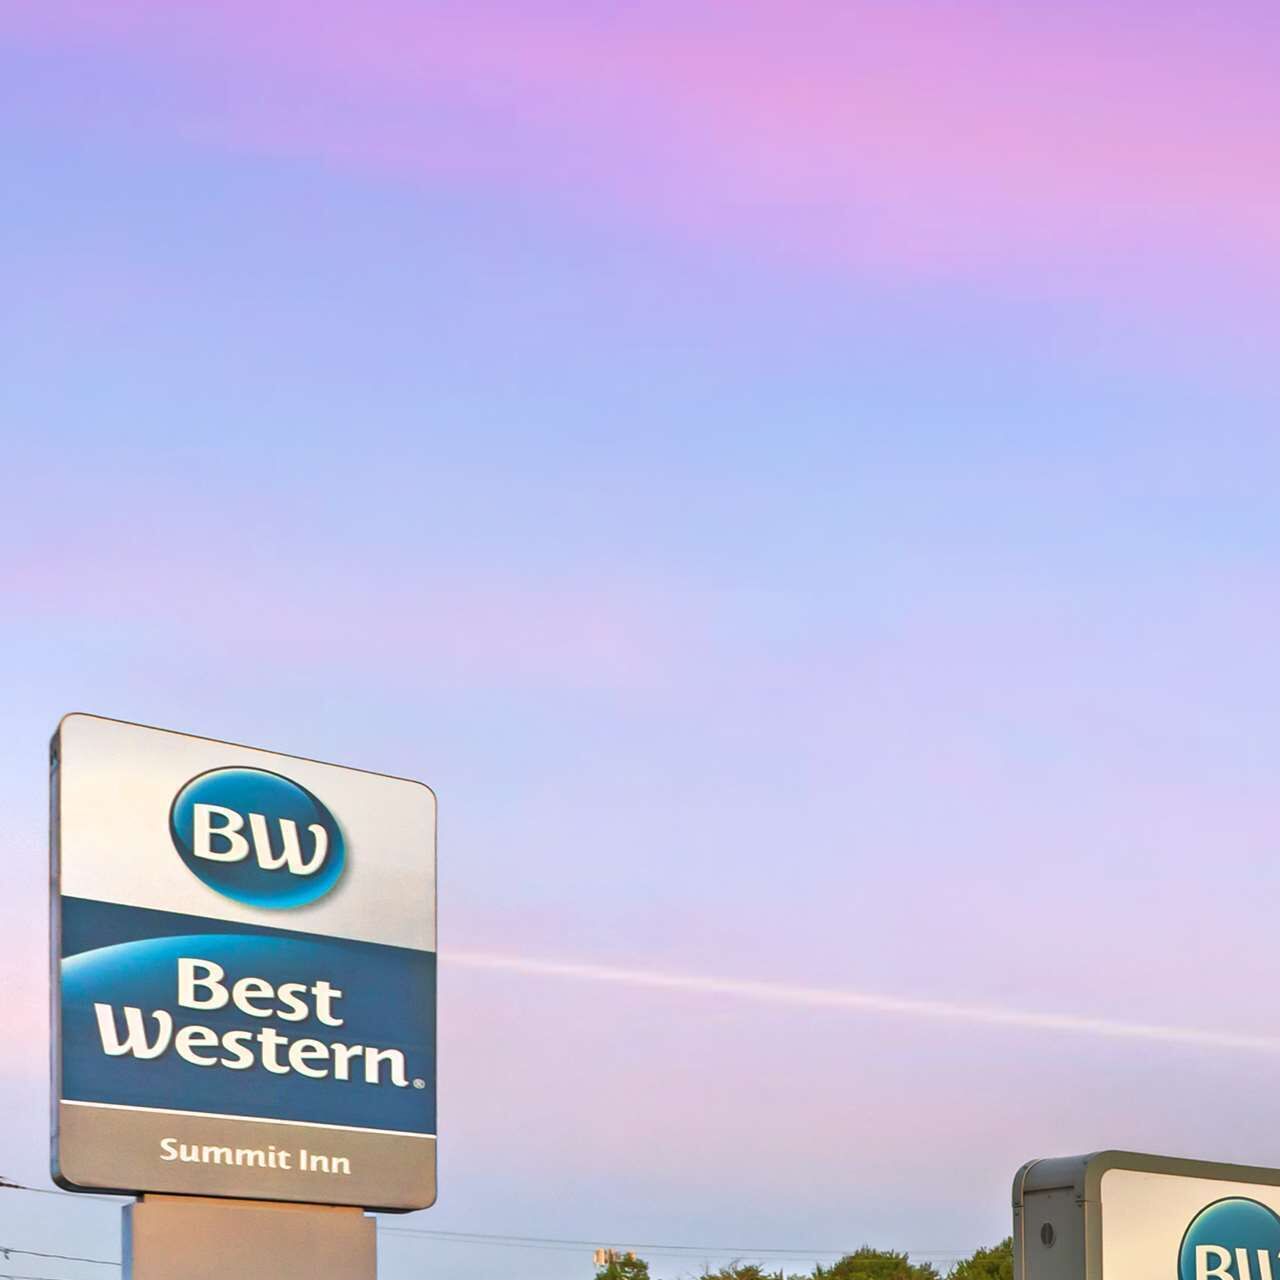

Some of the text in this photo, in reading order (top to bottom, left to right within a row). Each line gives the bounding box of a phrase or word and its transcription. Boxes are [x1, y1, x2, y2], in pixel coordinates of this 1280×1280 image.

[191, 802, 329, 876] BW
[176, 957, 345, 1027] Best
[159, 1137, 352, 1175] Summit Inn
